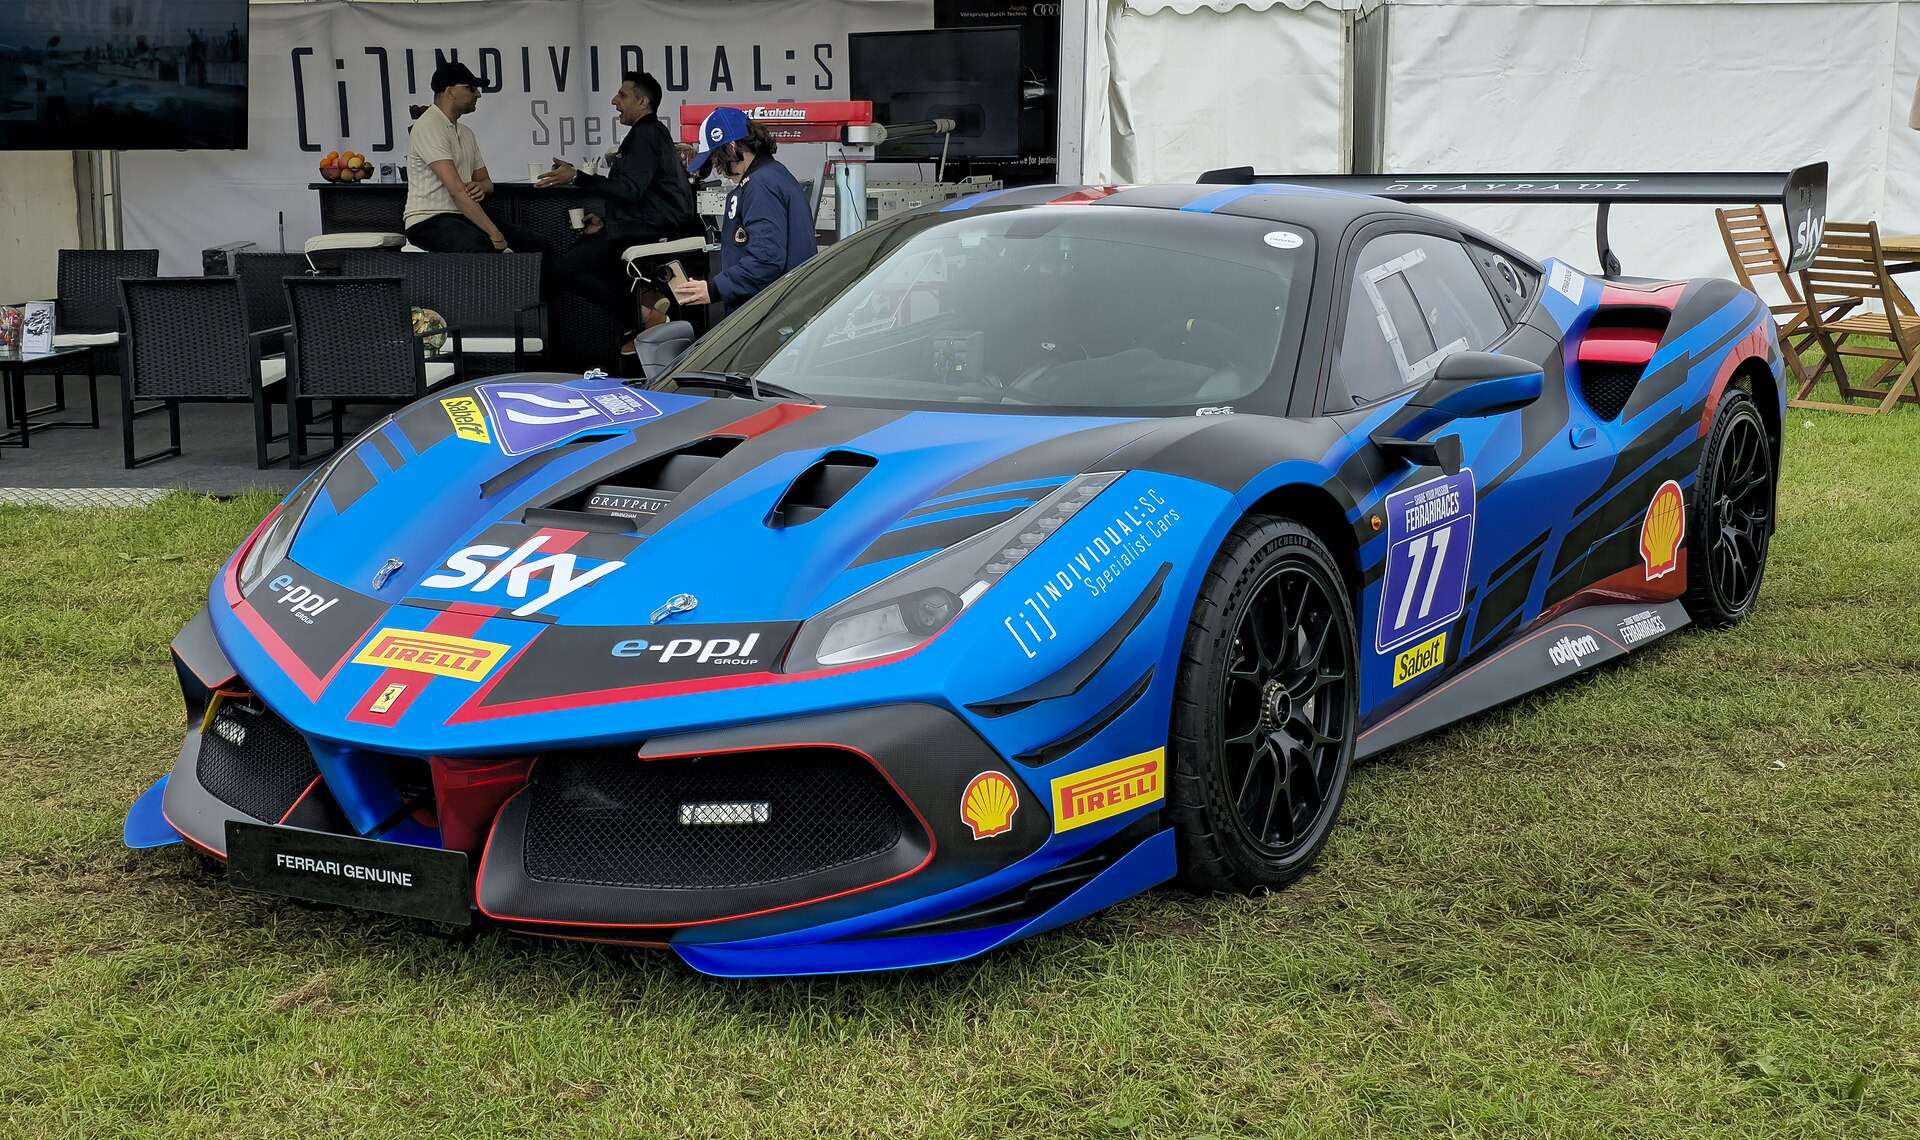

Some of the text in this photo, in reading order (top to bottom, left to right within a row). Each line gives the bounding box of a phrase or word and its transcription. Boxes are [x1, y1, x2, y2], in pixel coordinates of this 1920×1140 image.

[754, 106, 806, 120] Evolution
[1384, 183, 1630, 191] GRAYPAUL
[728, 195, 738, 219] 3
[1794, 208, 1825, 262] sky
[445, 400, 484, 436] Sabelt
[590, 496, 668, 511] GRAYPAU
[1083, 508, 1181, 598] Specialist Cars
[1266, 535, 1308, 555] MICHELIN
[420, 535, 627, 617] sky
[268, 574, 340, 617] e-ppl
[294, 611, 314, 625] GROUP
[368, 635, 492, 672] PIRELLI
[611, 632, 761, 664] e-ppl
[713, 658, 758, 666] GROUP
[1398, 640, 1440, 681] Sabelt
[1548, 634, 1601, 667] rotiform
[1060, 760, 1158, 821] PIRELLI
[276, 853, 413, 887] FERRARI GENUINE
